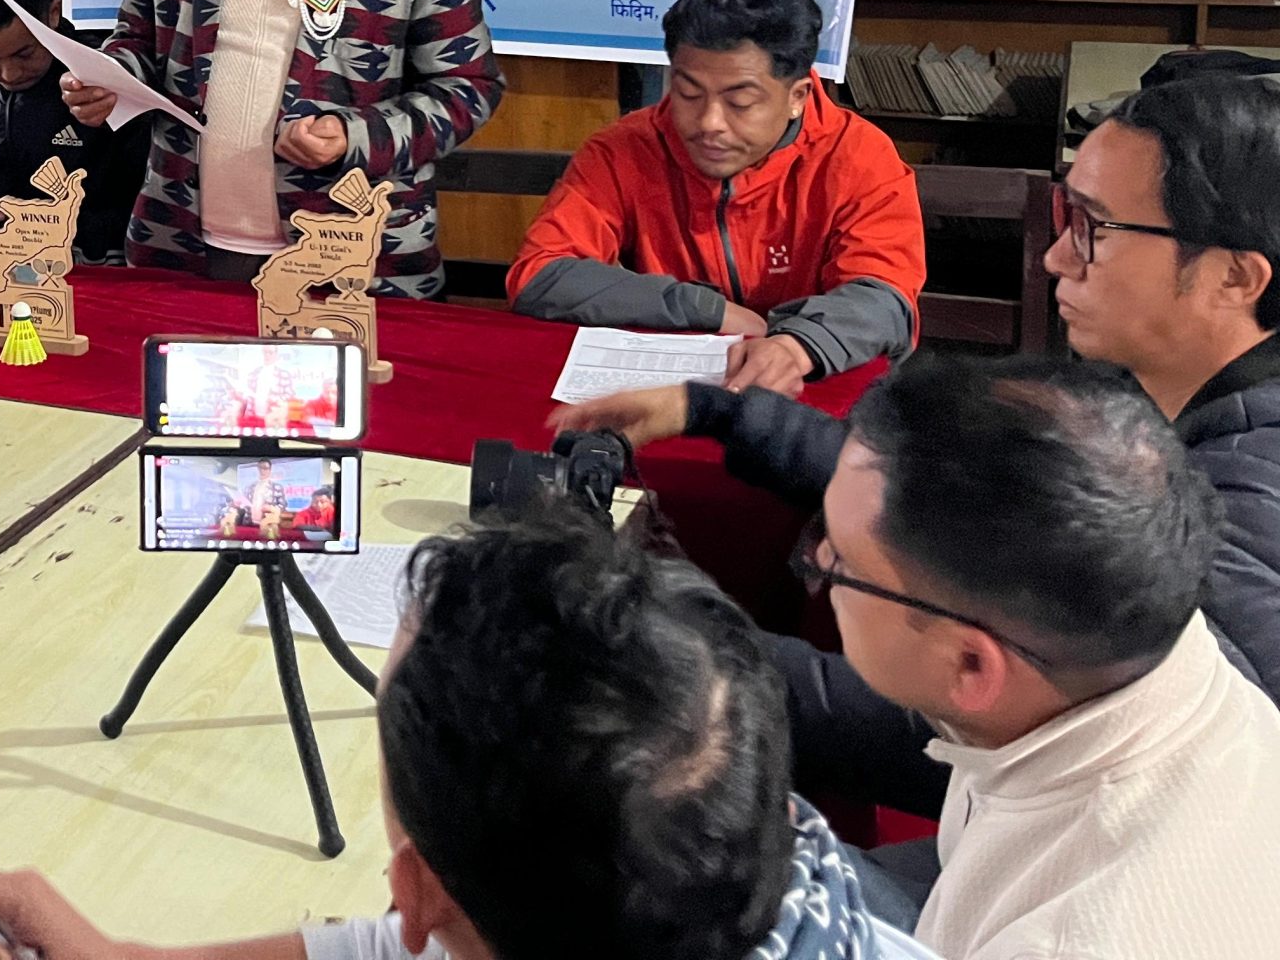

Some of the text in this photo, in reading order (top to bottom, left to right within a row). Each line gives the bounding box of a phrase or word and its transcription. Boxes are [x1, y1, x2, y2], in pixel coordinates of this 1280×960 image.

[51, 138, 83, 146] adidas
[21, 213, 60, 224] WINNER
[319, 230, 363, 241] WINNER
